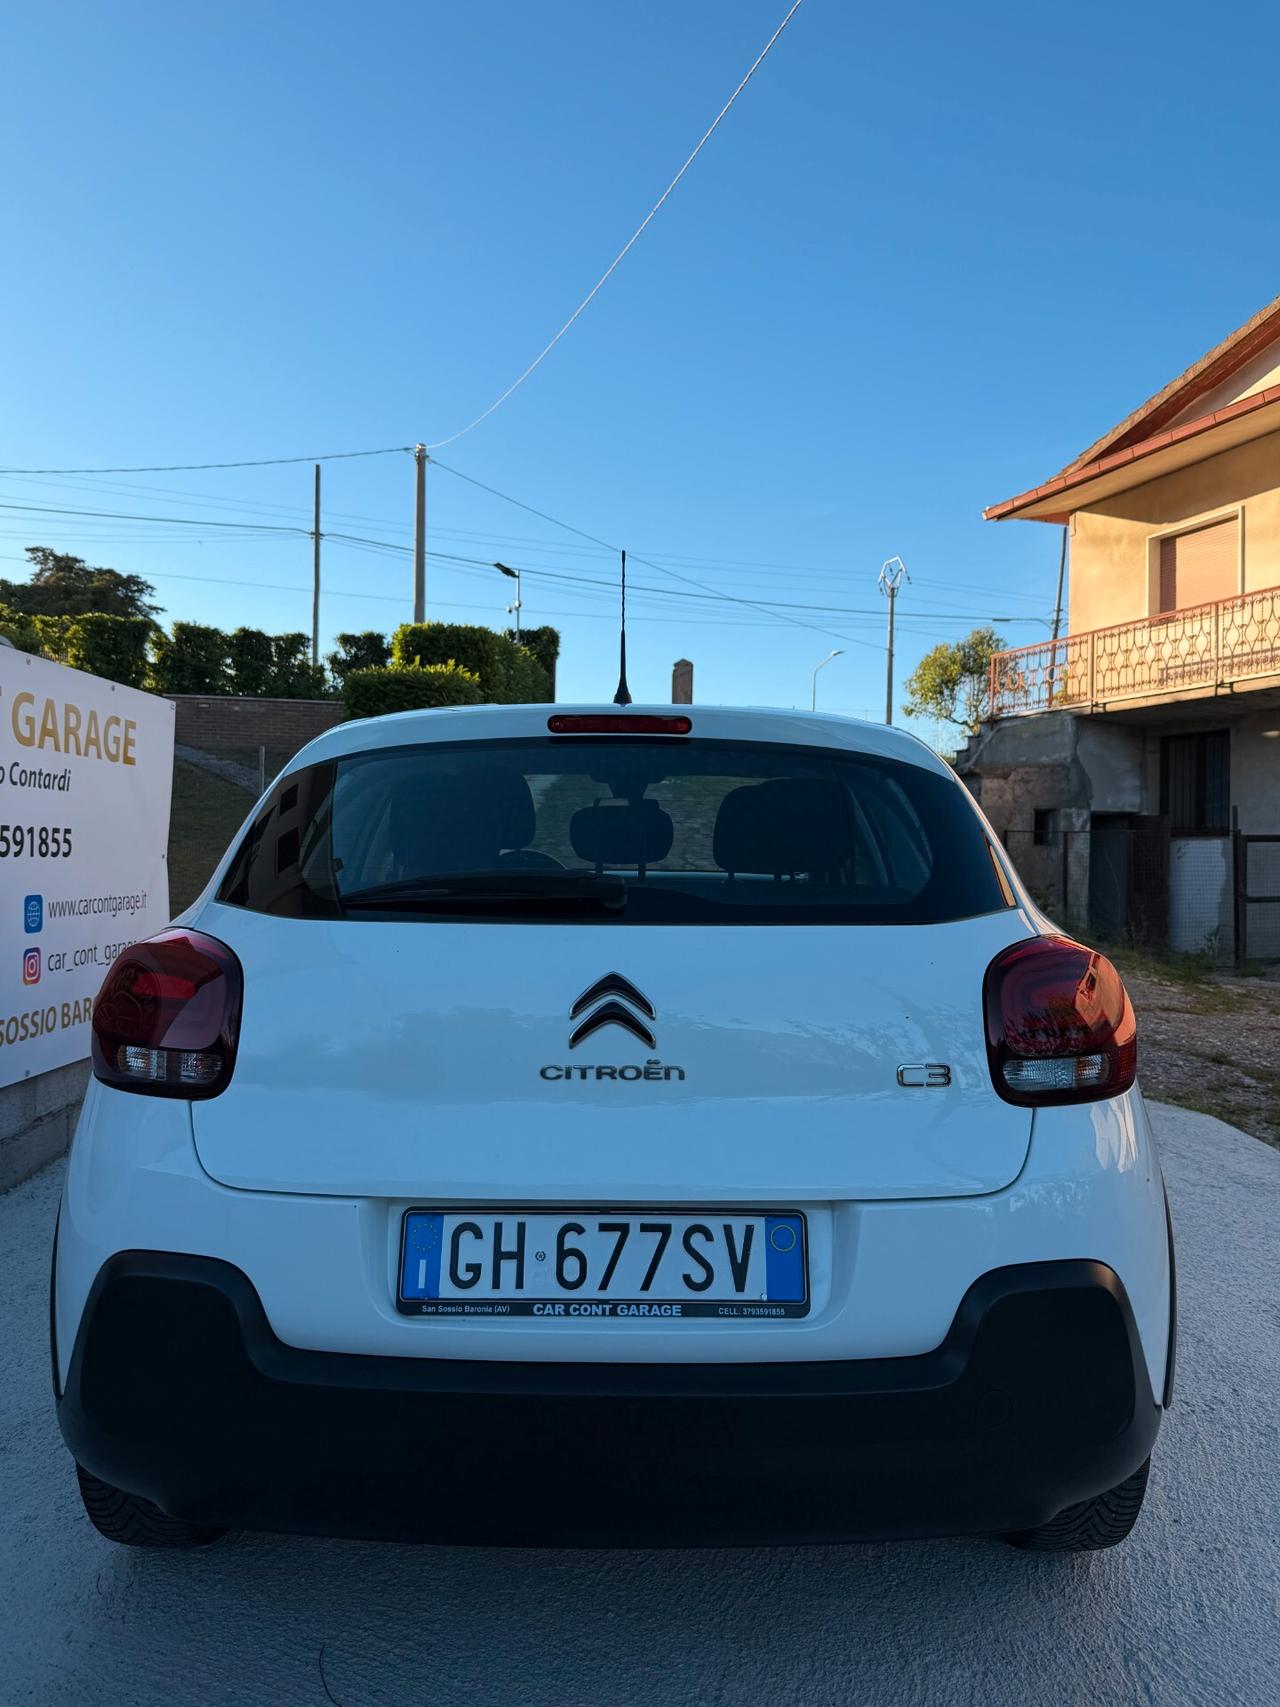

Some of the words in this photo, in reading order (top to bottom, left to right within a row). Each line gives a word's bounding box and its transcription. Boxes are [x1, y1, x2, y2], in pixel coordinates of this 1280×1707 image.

[12, 691, 137, 766] GARAGE
[9, 761, 72, 792] Contardi
[0, 824, 72, 858] 591855
[48, 889, 147, 919] www.carcontgarage.it
[897, 1063, 952, 1087] C3
[449, 1222, 526, 1290] GH
[421, 1305, 436, 1313] San
[438, 1305, 463, 1313] Sossio
[464, 1305, 493, 1314] Baronia
[494, 1305, 510, 1314] (AV)
[532, 1304, 566, 1316] CAR
[569, 1304, 612, 1316] CONT
[616, 1304, 682, 1316] GARAGE
[718, 1307, 740, 1315] CELL.
